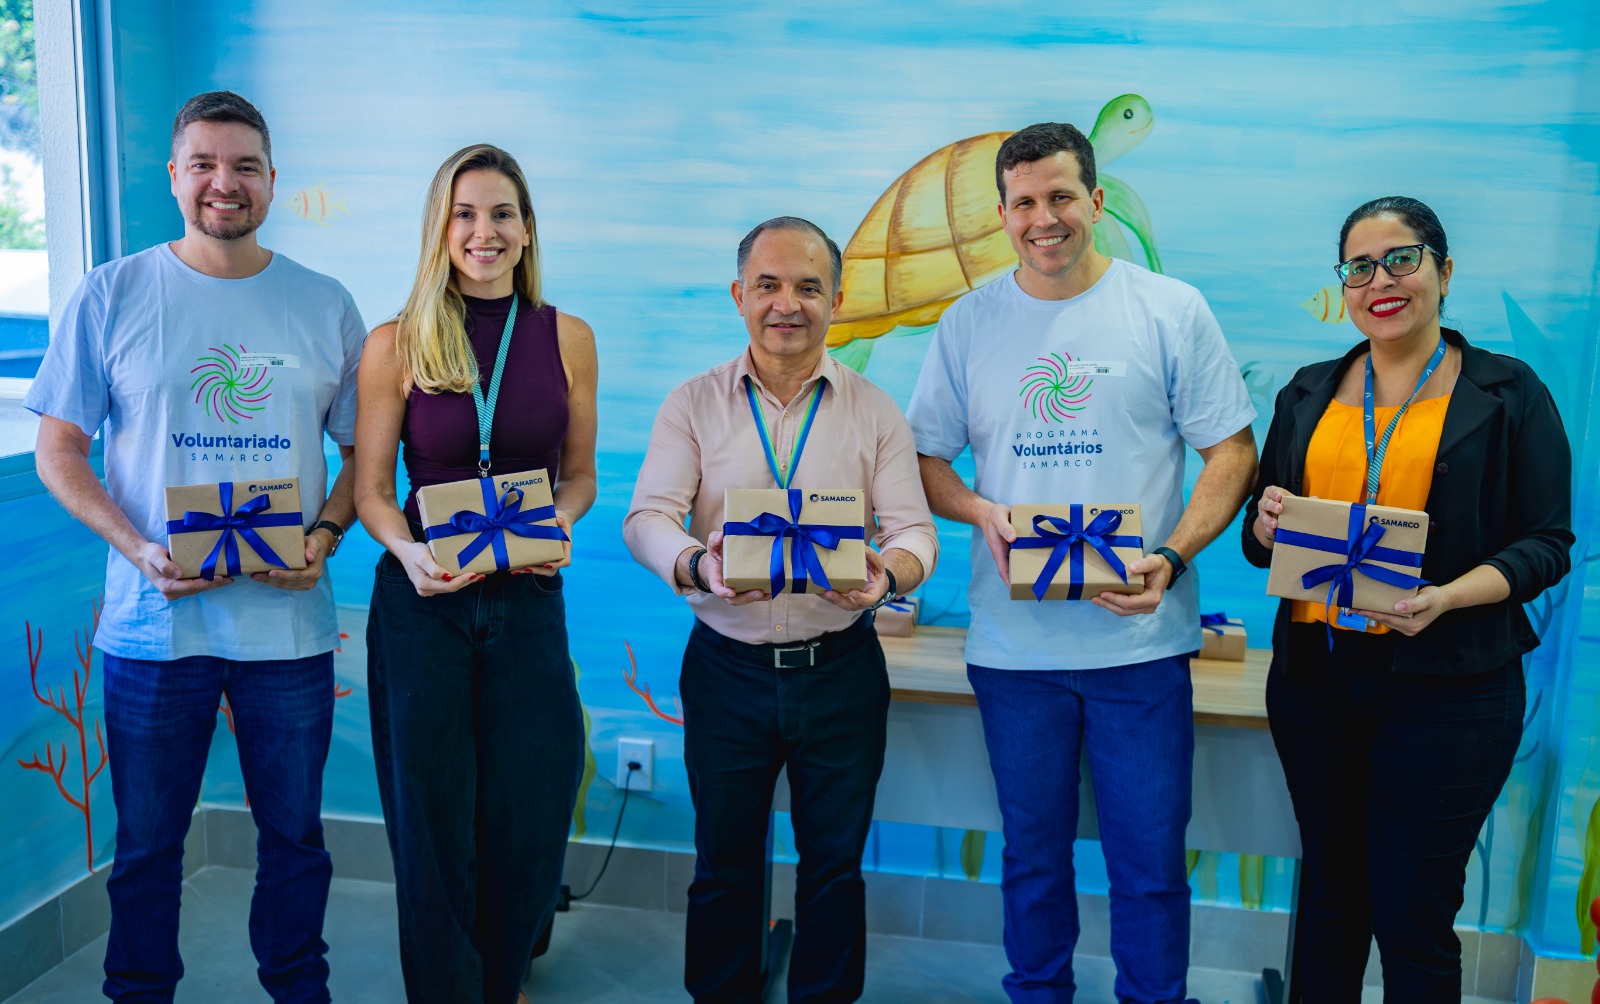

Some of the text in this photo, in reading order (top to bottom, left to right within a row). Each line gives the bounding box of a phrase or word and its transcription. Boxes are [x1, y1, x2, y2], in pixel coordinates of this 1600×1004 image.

[1016, 429, 1099, 440] PROGRAMA
[171, 432, 291, 449] Voluntariado
[1012, 441, 1103, 457] Voluntários
[191, 453, 273, 462] SAMARCO
[1023, 459, 1092, 469] SAMARCO
[511, 477, 543, 487] SAMARCO
[259, 483, 293, 492] SAMARCO
[1380, 518, 1420, 529] SAMARCO
